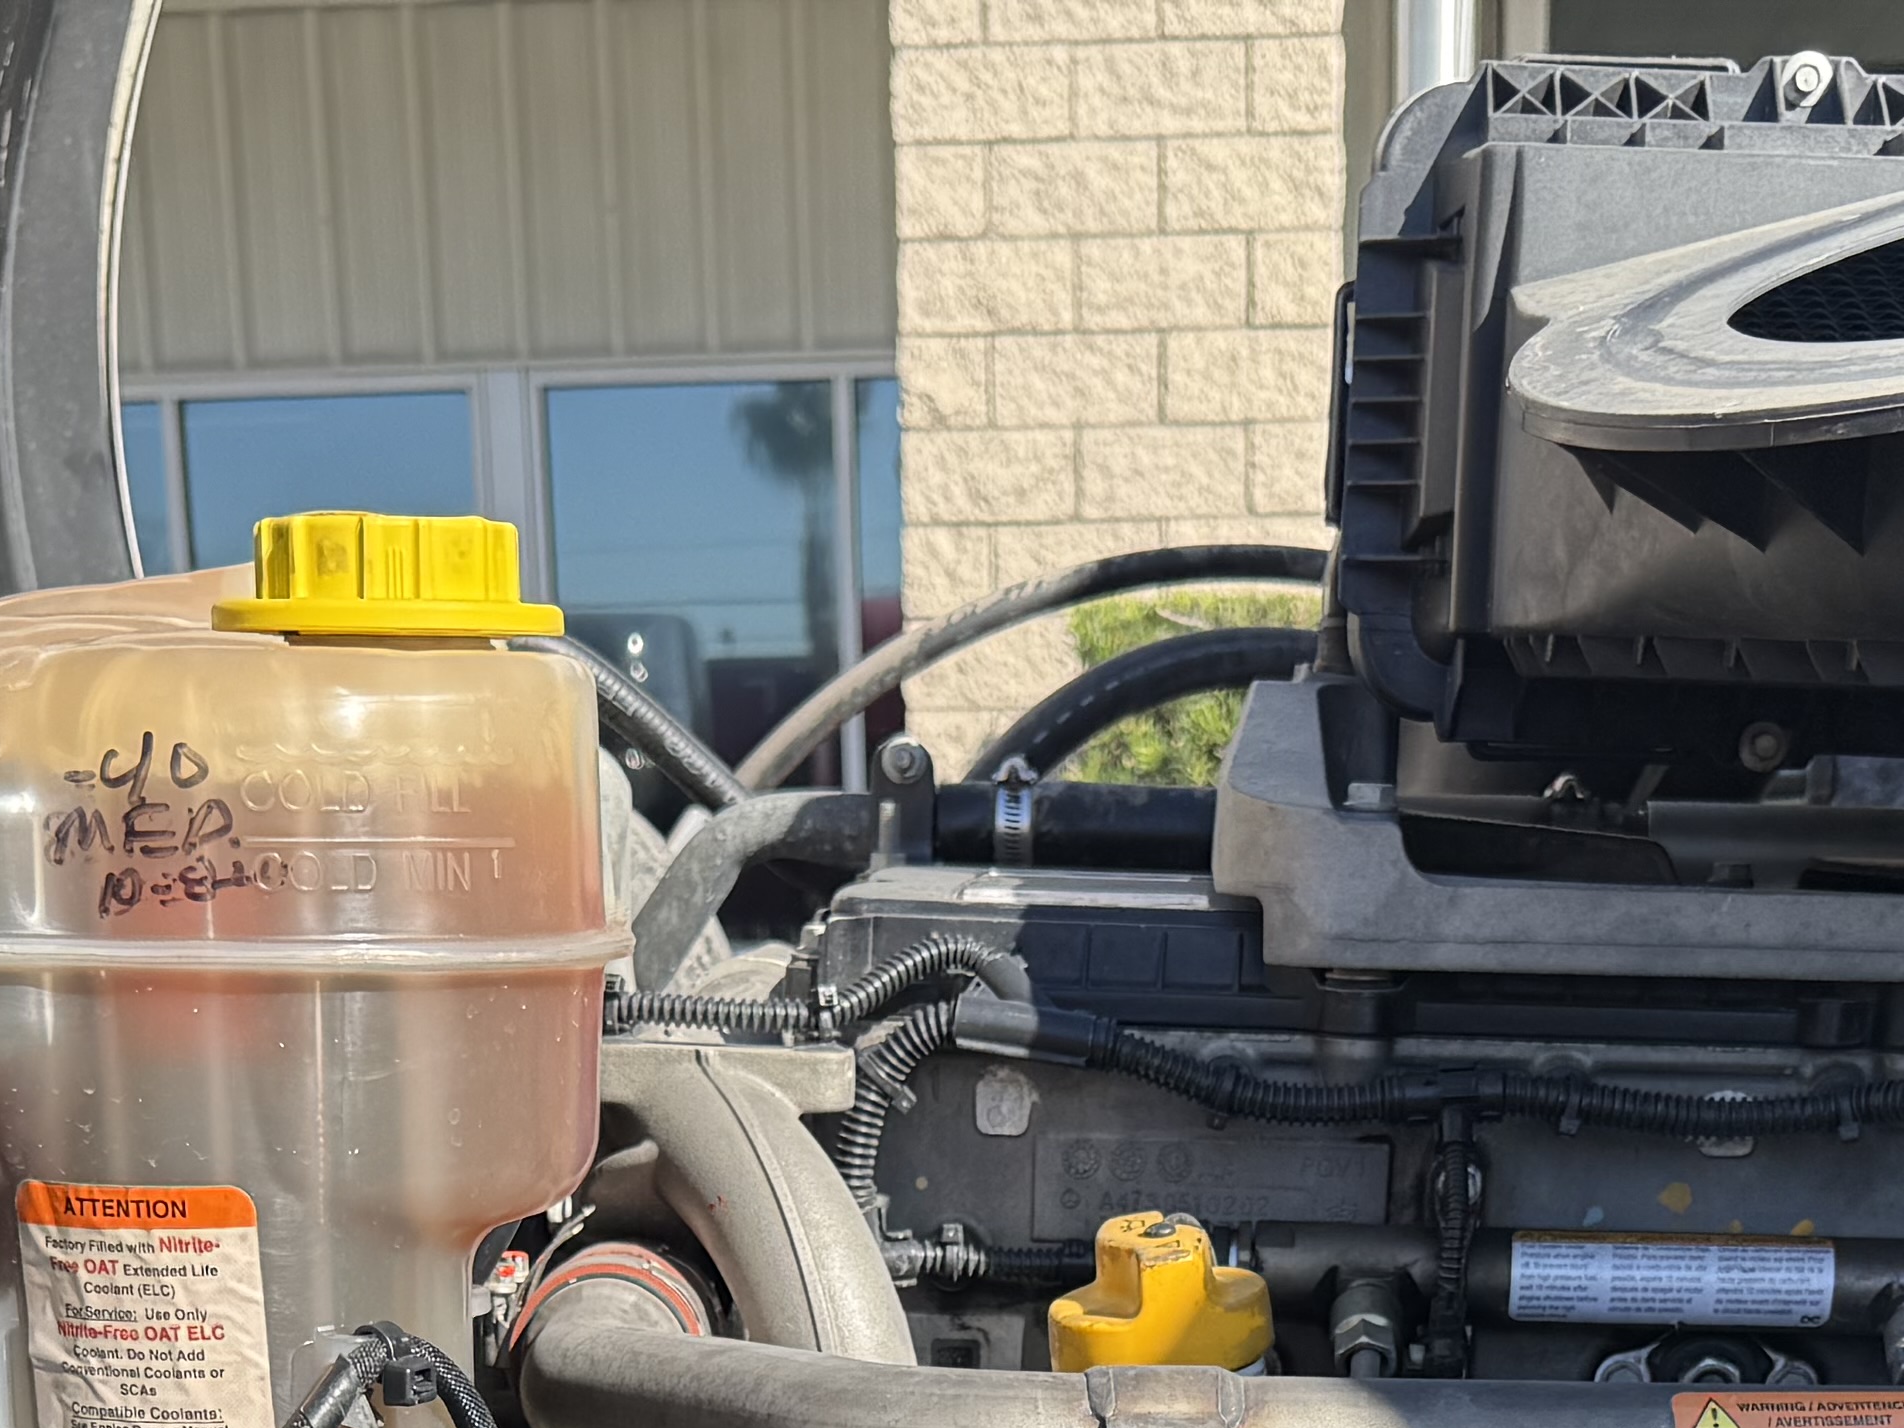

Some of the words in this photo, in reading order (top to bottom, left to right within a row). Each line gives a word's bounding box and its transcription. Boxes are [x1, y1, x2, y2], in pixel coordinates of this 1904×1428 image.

[240, 769, 371, 813] COLD
[396, 774, 472, 814] FILL
[253, 851, 377, 892] COLD
[403, 849, 472, 893] MIN
[63, 1196, 187, 1219] ATTENTION
[45, 1235, 86, 1252] Factory
[89, 1239, 124, 1254] Filled
[125, 1241, 155, 1254] with
[159, 1236, 221, 1256] Nitrite-
[50, 1257, 79, 1274] Free
[84, 1259, 119, 1275] OAT
[123, 1263, 187, 1278] Extended
[191, 1264, 219, 1277] Life
[84, 1281, 134, 1297] Coolant
[137, 1283, 176, 1299] (ELC)
[65, 1303, 83, 1318] For
[145, 1308, 171, 1322] Use
[174, 1308, 208, 1323] Only
[58, 1323, 139, 1341] Nitrite-Free
[144, 1326, 180, 1342] OAT
[188, 1325, 225, 1341] ELC
[127, 1348, 145, 1361] Do
[149, 1349, 173, 1362] Not
[177, 1350, 205, 1362] Add
[61, 1362, 141, 1379] Conventional
[144, 1366, 206, 1380] Coolants
[210, 1368, 225, 1379] or
[120, 1383, 157, 1397] SCAs
[71, 1401, 145, 1420] Compatible
[150, 1407, 222, 1421] Coolants:
[1736, 1400, 1806, 1413] WARNING
[1775, 1414, 1894, 1428] AVERTISSEMENT
